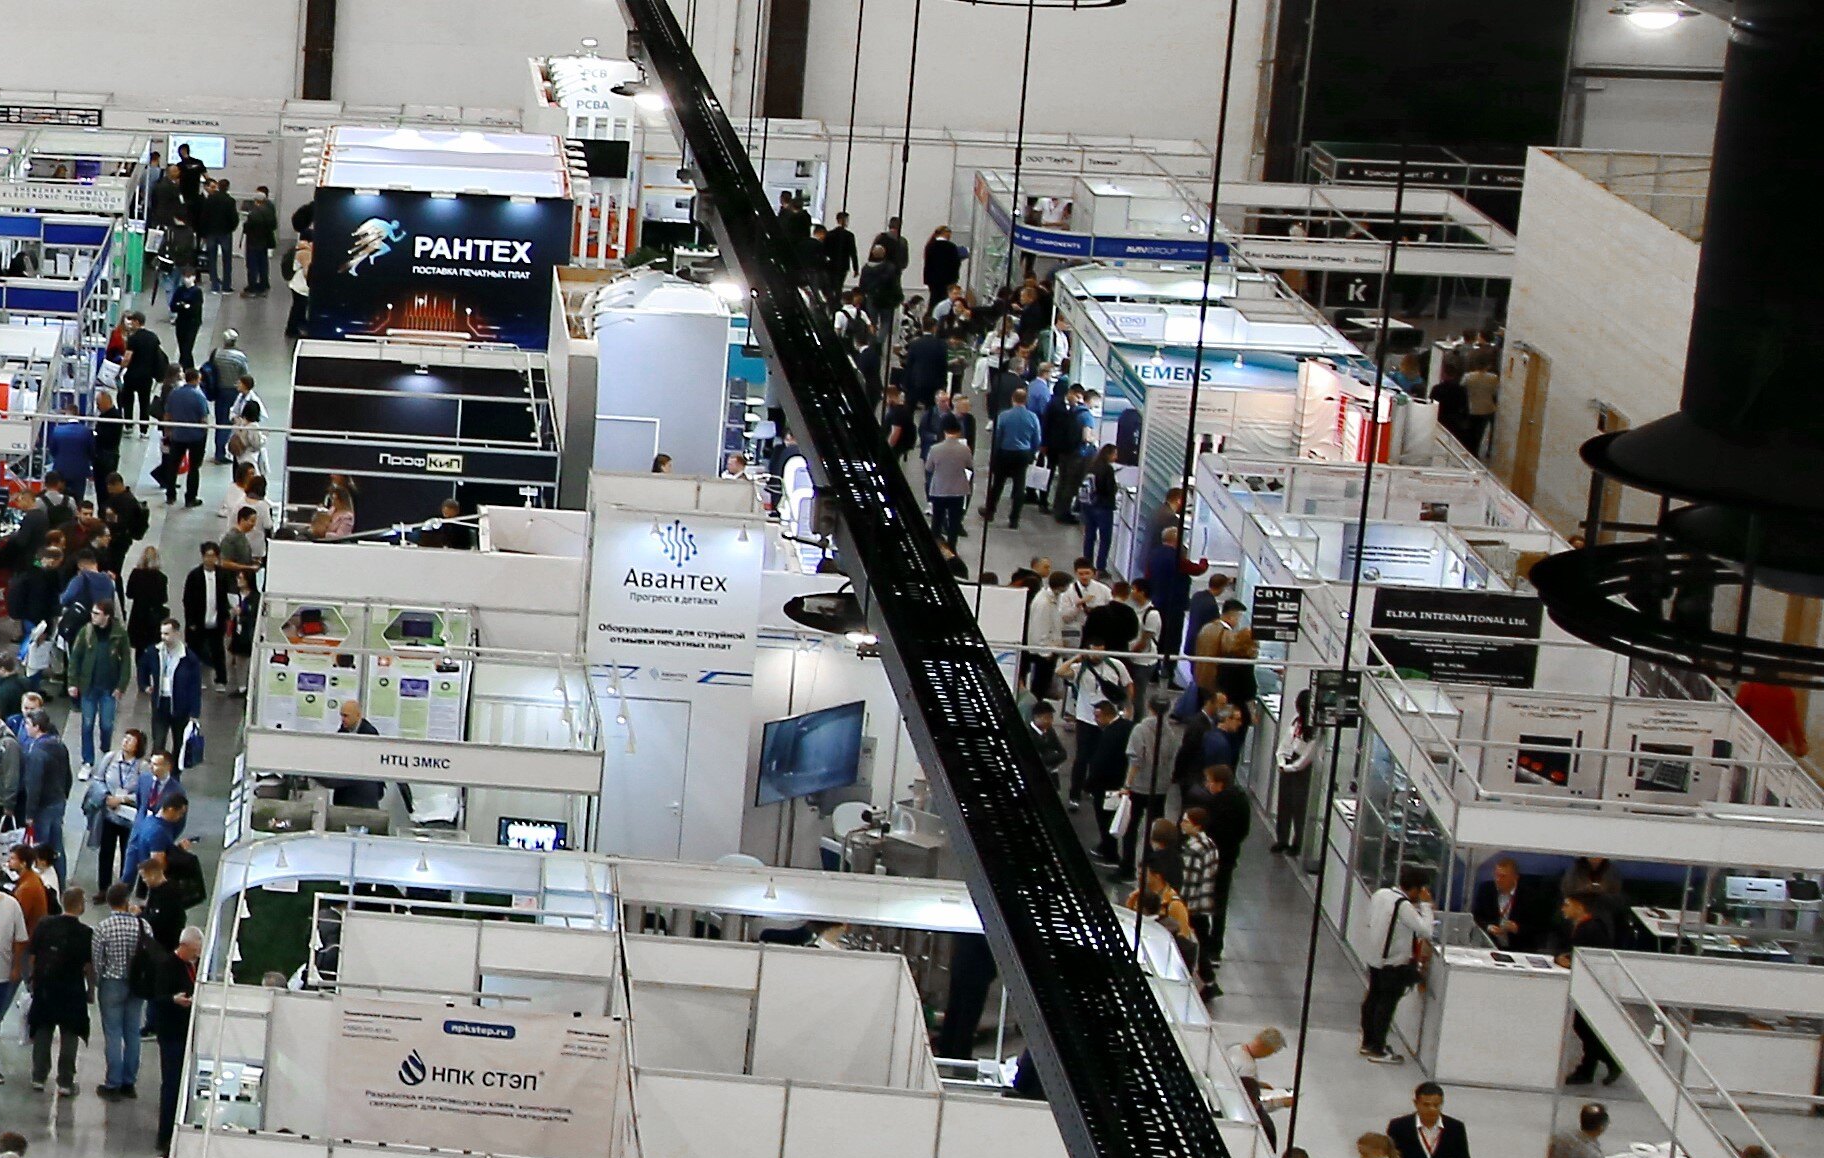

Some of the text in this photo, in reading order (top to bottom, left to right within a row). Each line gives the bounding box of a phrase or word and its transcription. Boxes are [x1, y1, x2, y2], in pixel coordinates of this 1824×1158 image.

[576, 100, 610, 109] PCBA
[414, 235, 532, 264] РАНТЕХ
[412, 265, 531, 280] ПОСТАВКА ПЕЧАТНЫХ ПЛАТ
[623, 568, 728, 593] Авантех
[629, 591, 672, 604] Прогресс
[680, 596, 719, 606] деталях
[1385, 609, 1416, 620] ELIKA
[1419, 611, 1506, 626] INTERNATIONAL
[598, 622, 746, 641] Оборудование для струйной
[609, 636, 733, 651] отмывки печатных плат
[380, 753, 452, 771] НТЦ ЗМКС
[432, 1065, 538, 1092] НПК СТЭП
